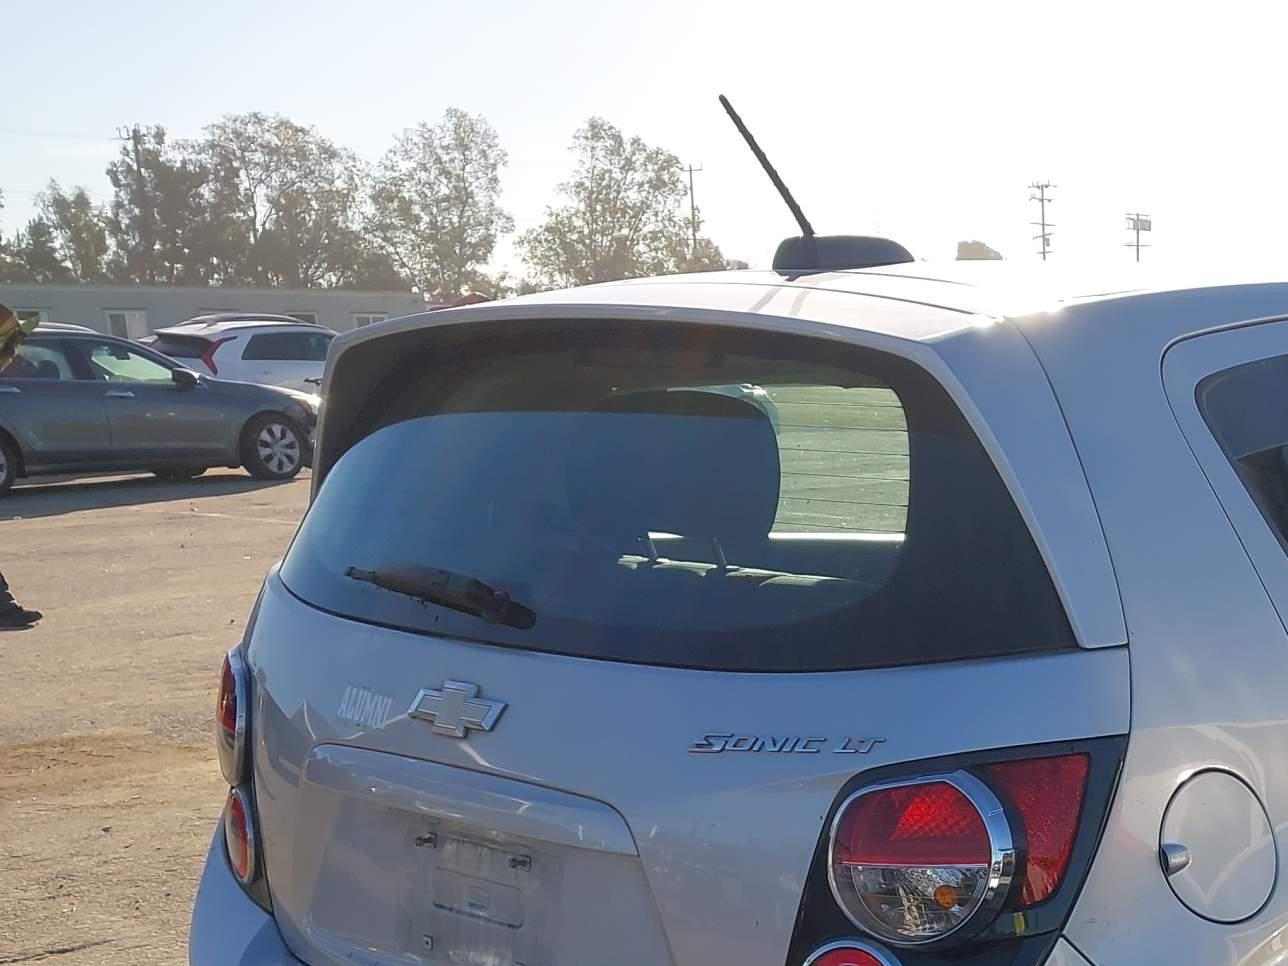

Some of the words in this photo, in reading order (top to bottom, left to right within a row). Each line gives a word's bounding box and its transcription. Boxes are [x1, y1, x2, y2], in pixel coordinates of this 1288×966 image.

[337, 686, 392, 730] ALUMNI
[688, 733, 828, 754] SONIC
[832, 737, 887, 754] LT
